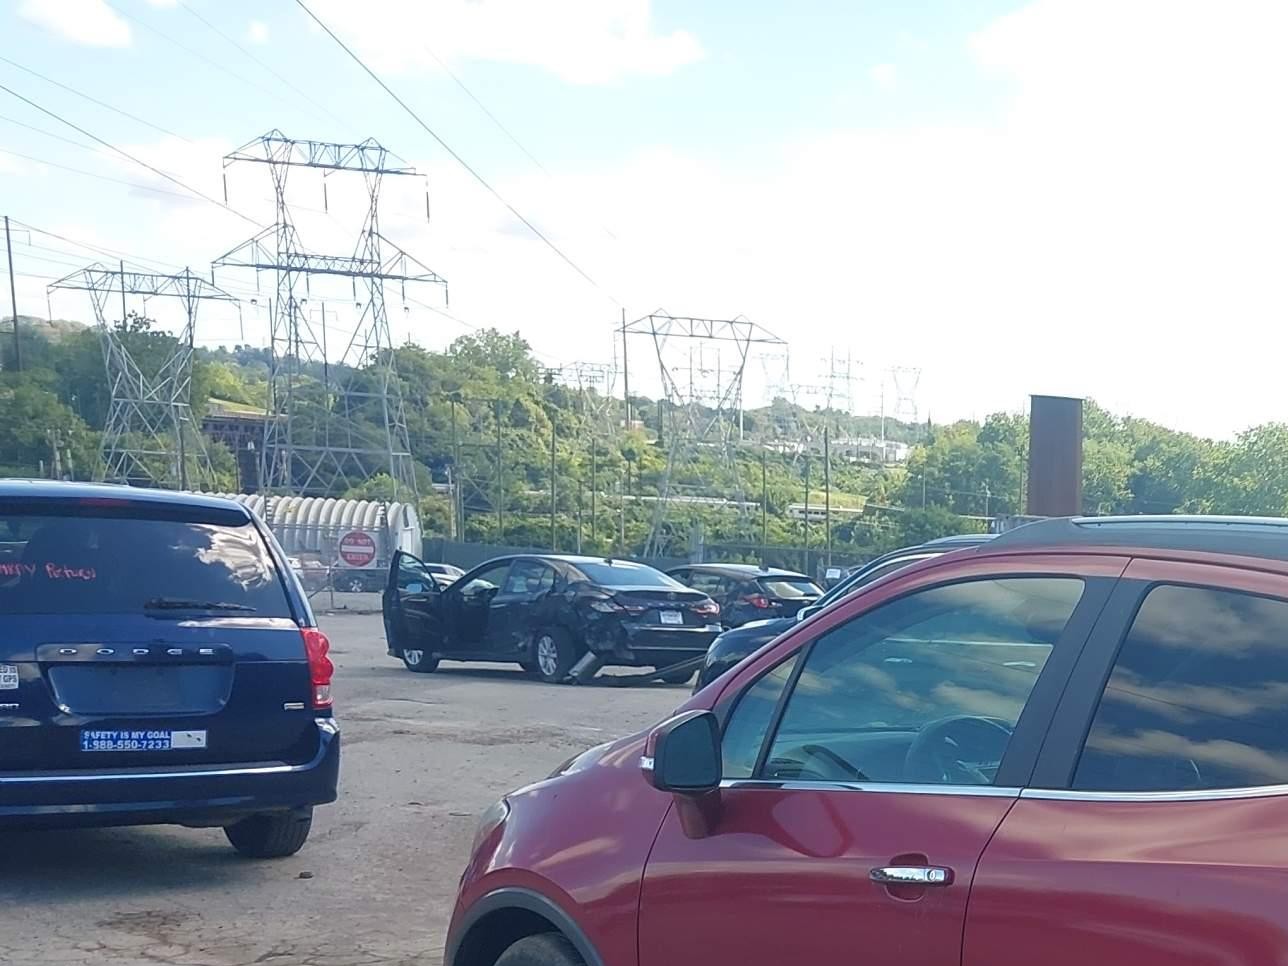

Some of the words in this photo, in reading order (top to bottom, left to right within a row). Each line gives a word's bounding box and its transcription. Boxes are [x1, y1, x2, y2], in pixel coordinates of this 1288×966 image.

[83, 730, 118, 739] SAFETY
[120, 731, 129, 739] IS
[131, 731, 145, 739] MY
[146, 731, 171, 739] GOAL
